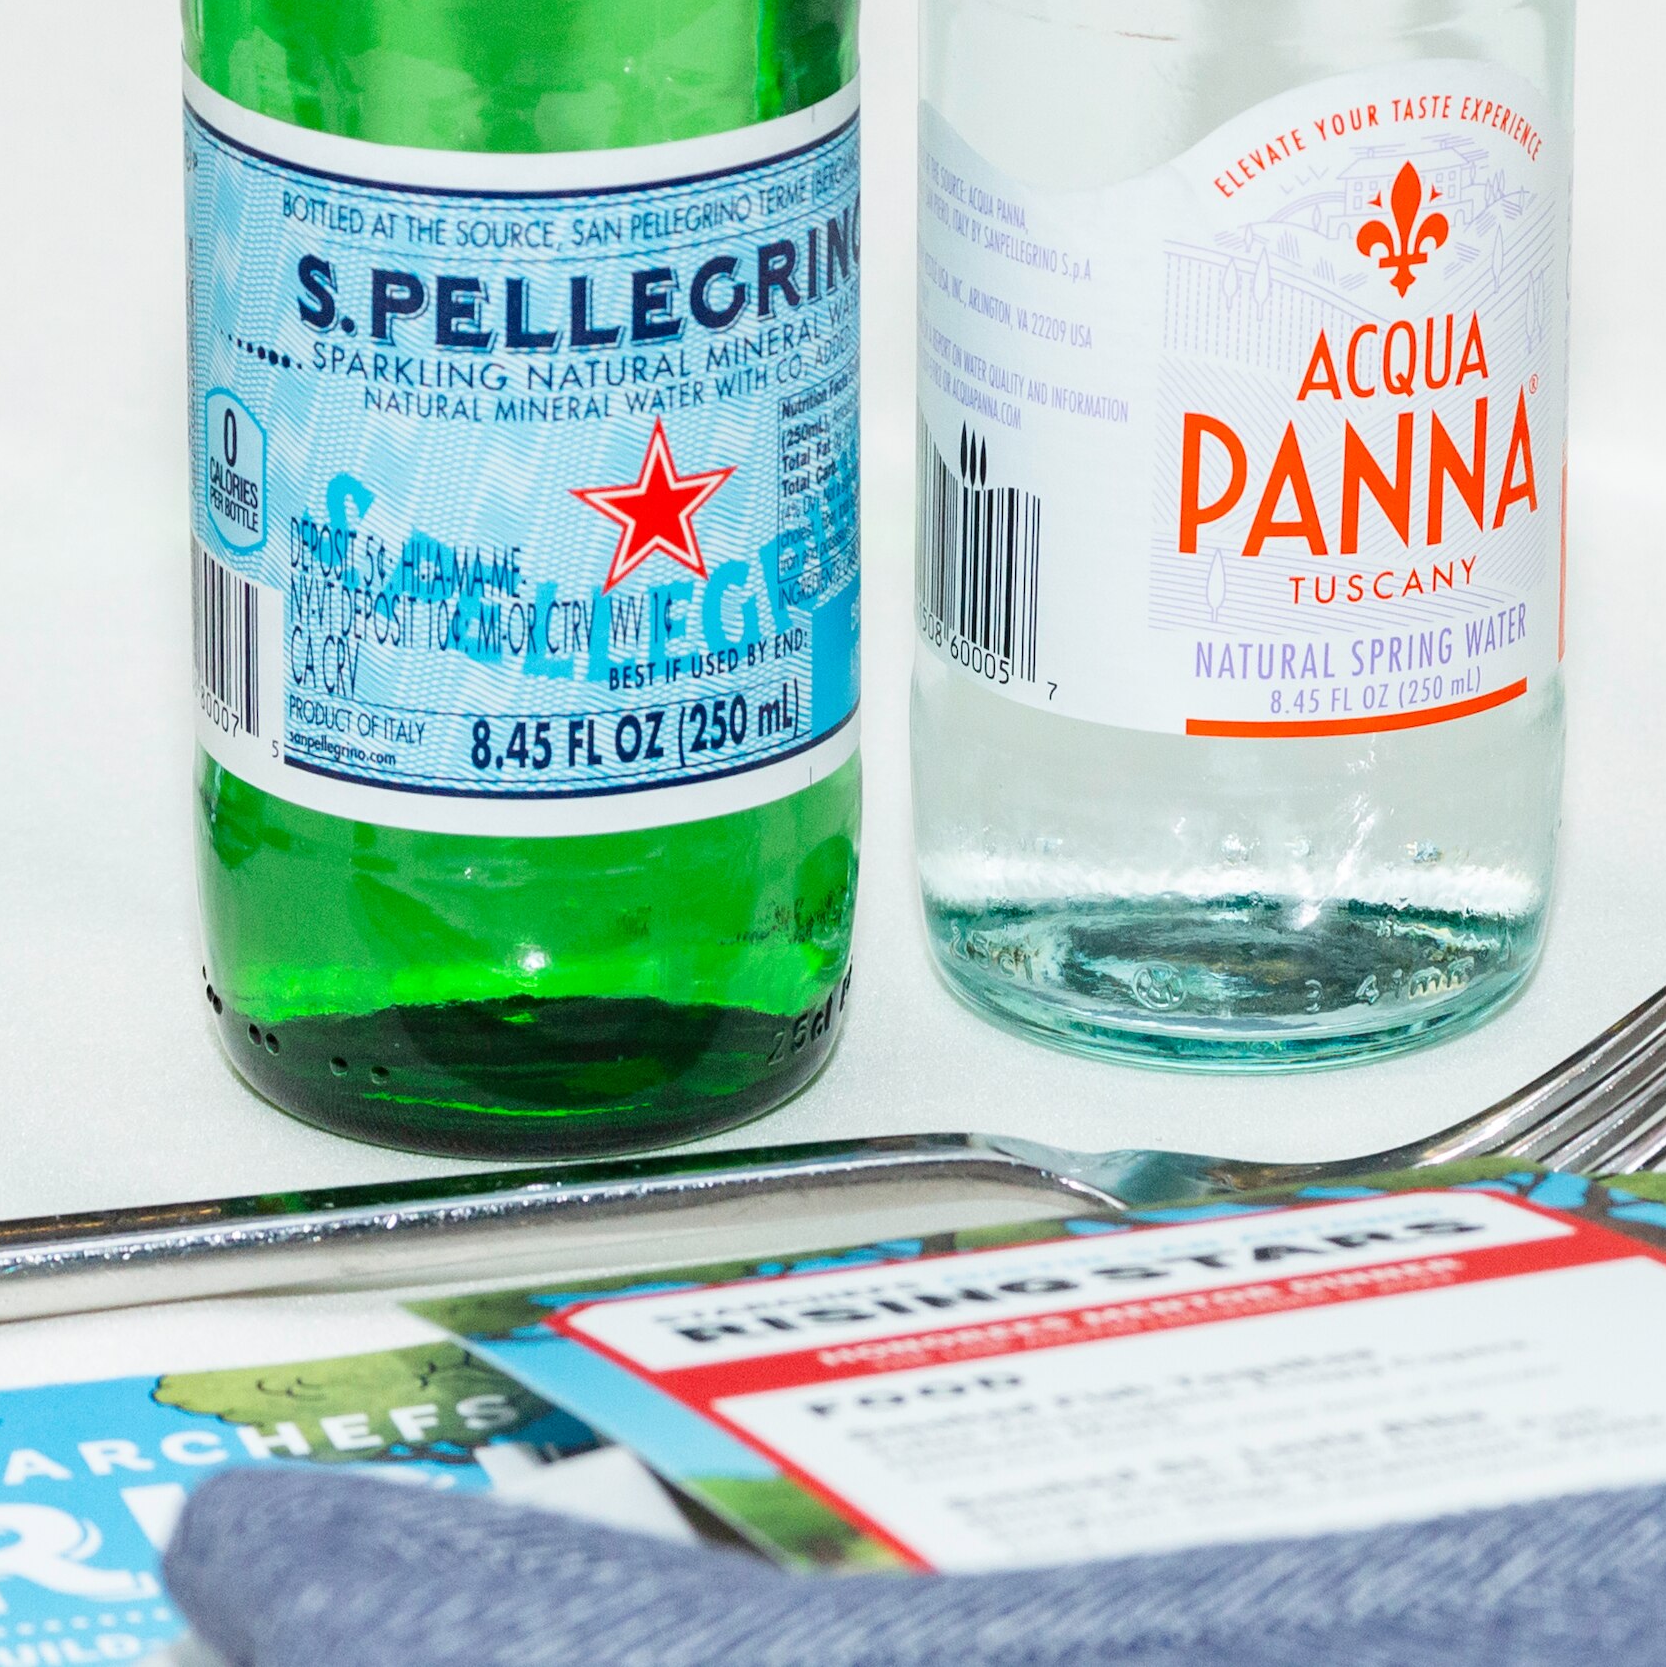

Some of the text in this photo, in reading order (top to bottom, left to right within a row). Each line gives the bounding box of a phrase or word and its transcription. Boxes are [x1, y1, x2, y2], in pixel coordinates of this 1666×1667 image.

[1213, 94, 1544, 199] ELEVATE YOUR TASTE EXPERIENCE
[283, 190, 365, 235] BOTTLED
[370, 213, 397, 240] AT
[406, 215, 448, 246] THE
[456, 219, 563, 252] SOURCE,
[572, 217, 623, 247] SAN
[632, 193, 753, 240] PELLEGRINO
[968, 184, 995, 218] ACQUA
[983, 223, 1059, 275] SANPELLEGRINO
[312, 311, 821, 392] SPARKLING NATURAL MINERAL
[1030, 312, 1093, 350] 22209 USA
[1296, 309, 1490, 401] ACQUA
[364, 365, 768, 424] NATURAL MINERAL WATER WITH
[781, 386, 827, 419] Nutrition
[962, 347, 988, 383] WATER
[988, 362, 1026, 399] QUALITY
[1026, 377, 1049, 406] AND
[1050, 387, 1130, 424] INFORMATION
[223, 407, 238, 469] 0
[781, 447, 811, 474] Total
[209, 455, 259, 511] CALORIES
[781, 471, 811, 498] Total
[1178, 382, 1539, 557] PANNA
[223, 494, 260, 534] BOTTLE
[290, 516, 357, 582] DEPOSIT
[1289, 554, 1478, 605] TUSCANY
[341, 585, 418, 650] DEPOSIT
[545, 598, 597, 655] CTRV
[609, 592, 647, 646] WV
[1195, 601, 1528, 681] NATURAL SPRING WATER
[291, 625, 360, 700] CA CRV
[609, 625, 809, 692] BEST IF USED BY END:
[949, 633, 1059, 702] 60005 7
[289, 694, 426, 747] PRODUCT OF ITALY
[1270, 665, 1482, 716] 8.45 FL OZ (250 mL)
[288, 730, 397, 767] sanpellegrino.com
[470, 677, 801, 771] 8.45 FL OZ (250 mL)
[676, 1211, 1490, 1347] RISING STARS
